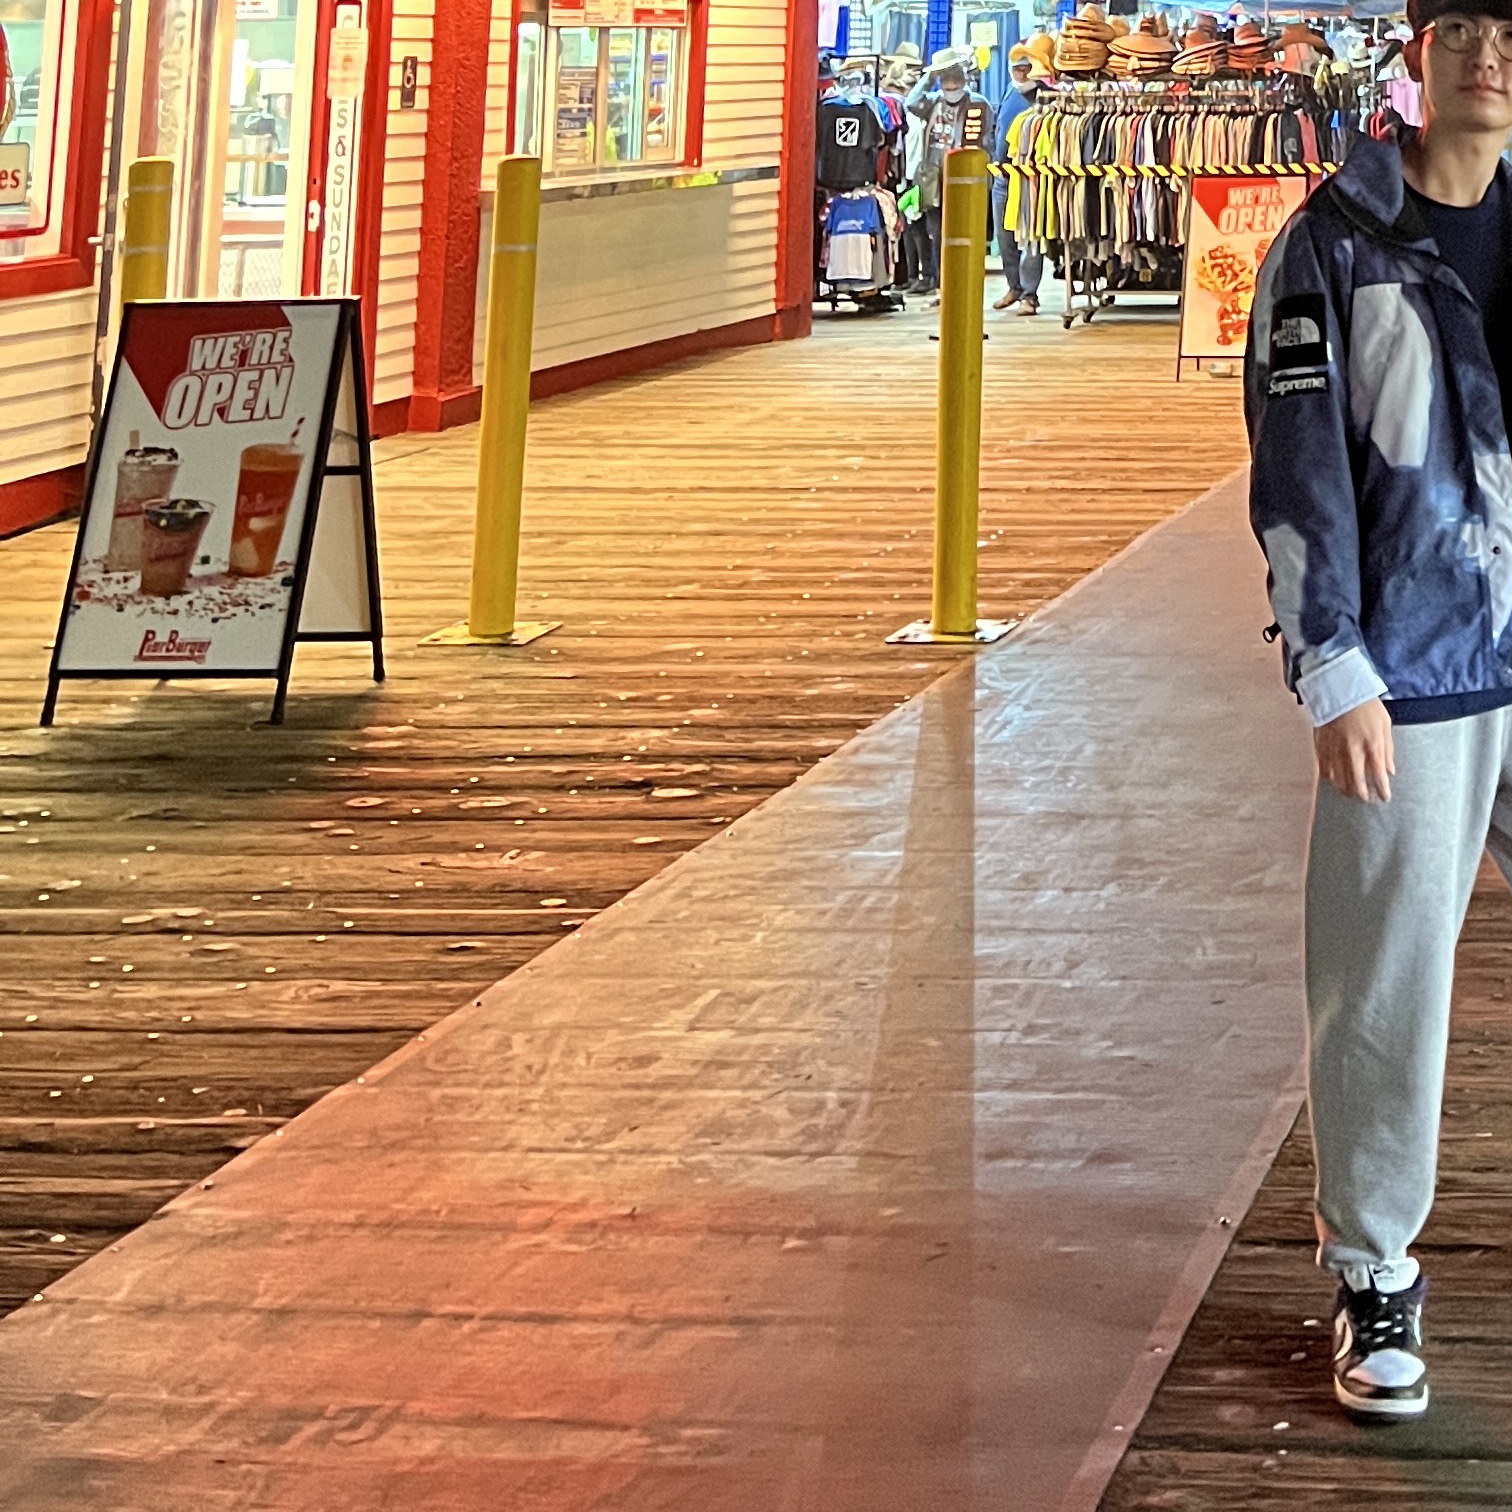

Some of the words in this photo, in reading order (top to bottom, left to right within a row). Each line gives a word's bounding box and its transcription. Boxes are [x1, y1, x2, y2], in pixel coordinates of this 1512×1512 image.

[1229, 187, 1280, 205] WE'RE
[1220, 203, 1284, 234] OPEN
[191, 331, 291, 372] WE'RE
[163, 364, 294, 429] OPEN
